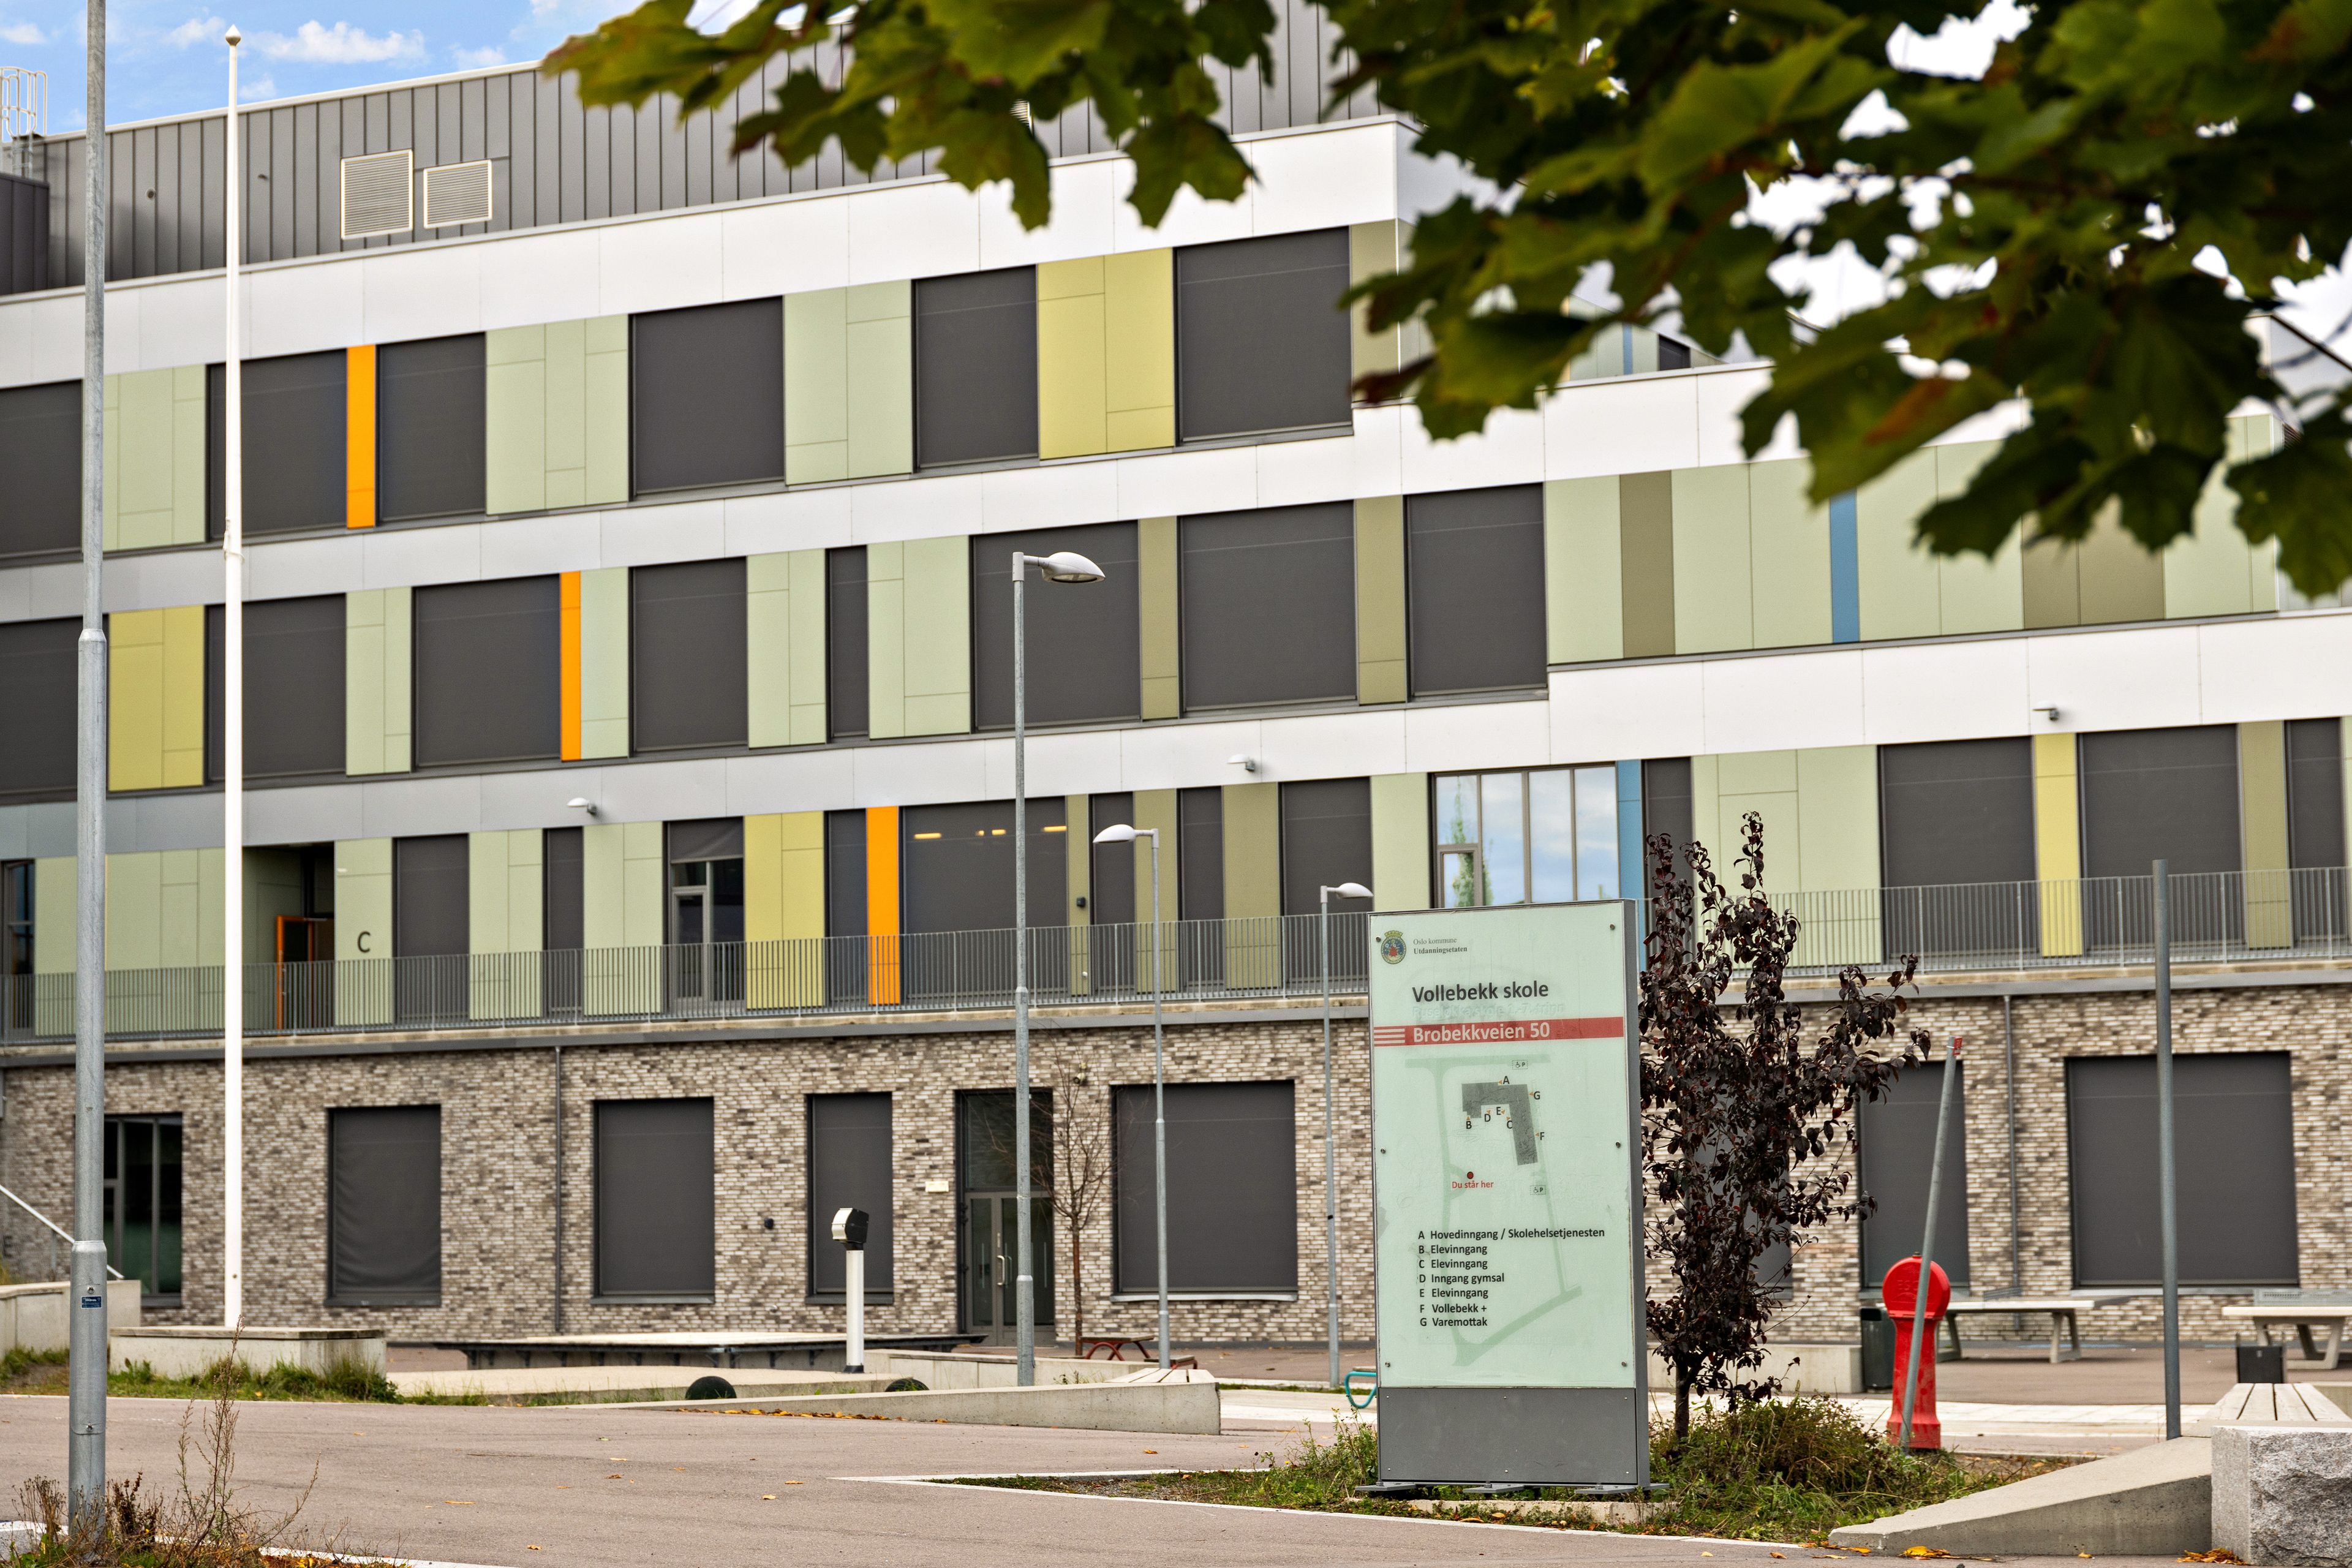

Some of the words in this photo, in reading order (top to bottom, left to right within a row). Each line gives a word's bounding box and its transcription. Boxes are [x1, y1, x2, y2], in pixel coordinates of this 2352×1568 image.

[357, 931, 371, 954] C
[1412, 982, 1499, 1003] Vollebekk
[1503, 980, 1549, 998] skole
[1413, 1023, 1525, 1043] Brobekkveien
[1530, 1022, 1550, 1038] 50
[1502, 1076, 1510, 1085] A
[1533, 1091, 1541, 1100] G
[1496, 1106, 1501, 1115] E
[1484, 1114, 1491, 1122] D
[1466, 1120, 1472, 1129] B
[1506, 1120, 1513, 1129] C
[1539, 1131, 1545, 1140] F
[1452, 1181, 1463, 1189] Du
[1464, 1180, 1479, 1189] står
[1480, 1180, 1494, 1189] her
[1418, 1231, 1425, 1240] A
[1430, 1229, 1498, 1241] Hovedinngang
[1500, 1228, 1506, 1240] /
[1508, 1227, 1605, 1240] Skolehelsetjenesten
[1419, 1245, 1425, 1254] B
[1430, 1243, 1488, 1256] Elevinngang
[1419, 1259, 1425, 1268] C
[1431, 1258, 1488, 1270] Elevinngang
[1419, 1274, 1426, 1283] D
[1431, 1273, 1469, 1285] Inngang
[1471, 1273, 1505, 1284] gymsal
[1419, 1288, 1425, 1298] E
[1431, 1287, 1488, 1299] Elevinngang
[1420, 1304, 1425, 1313] F
[1431, 1303, 1479, 1313] Vollebekk
[1420, 1317, 1427, 1327] G
[1432, 1316, 1488, 1327] Varemottak
